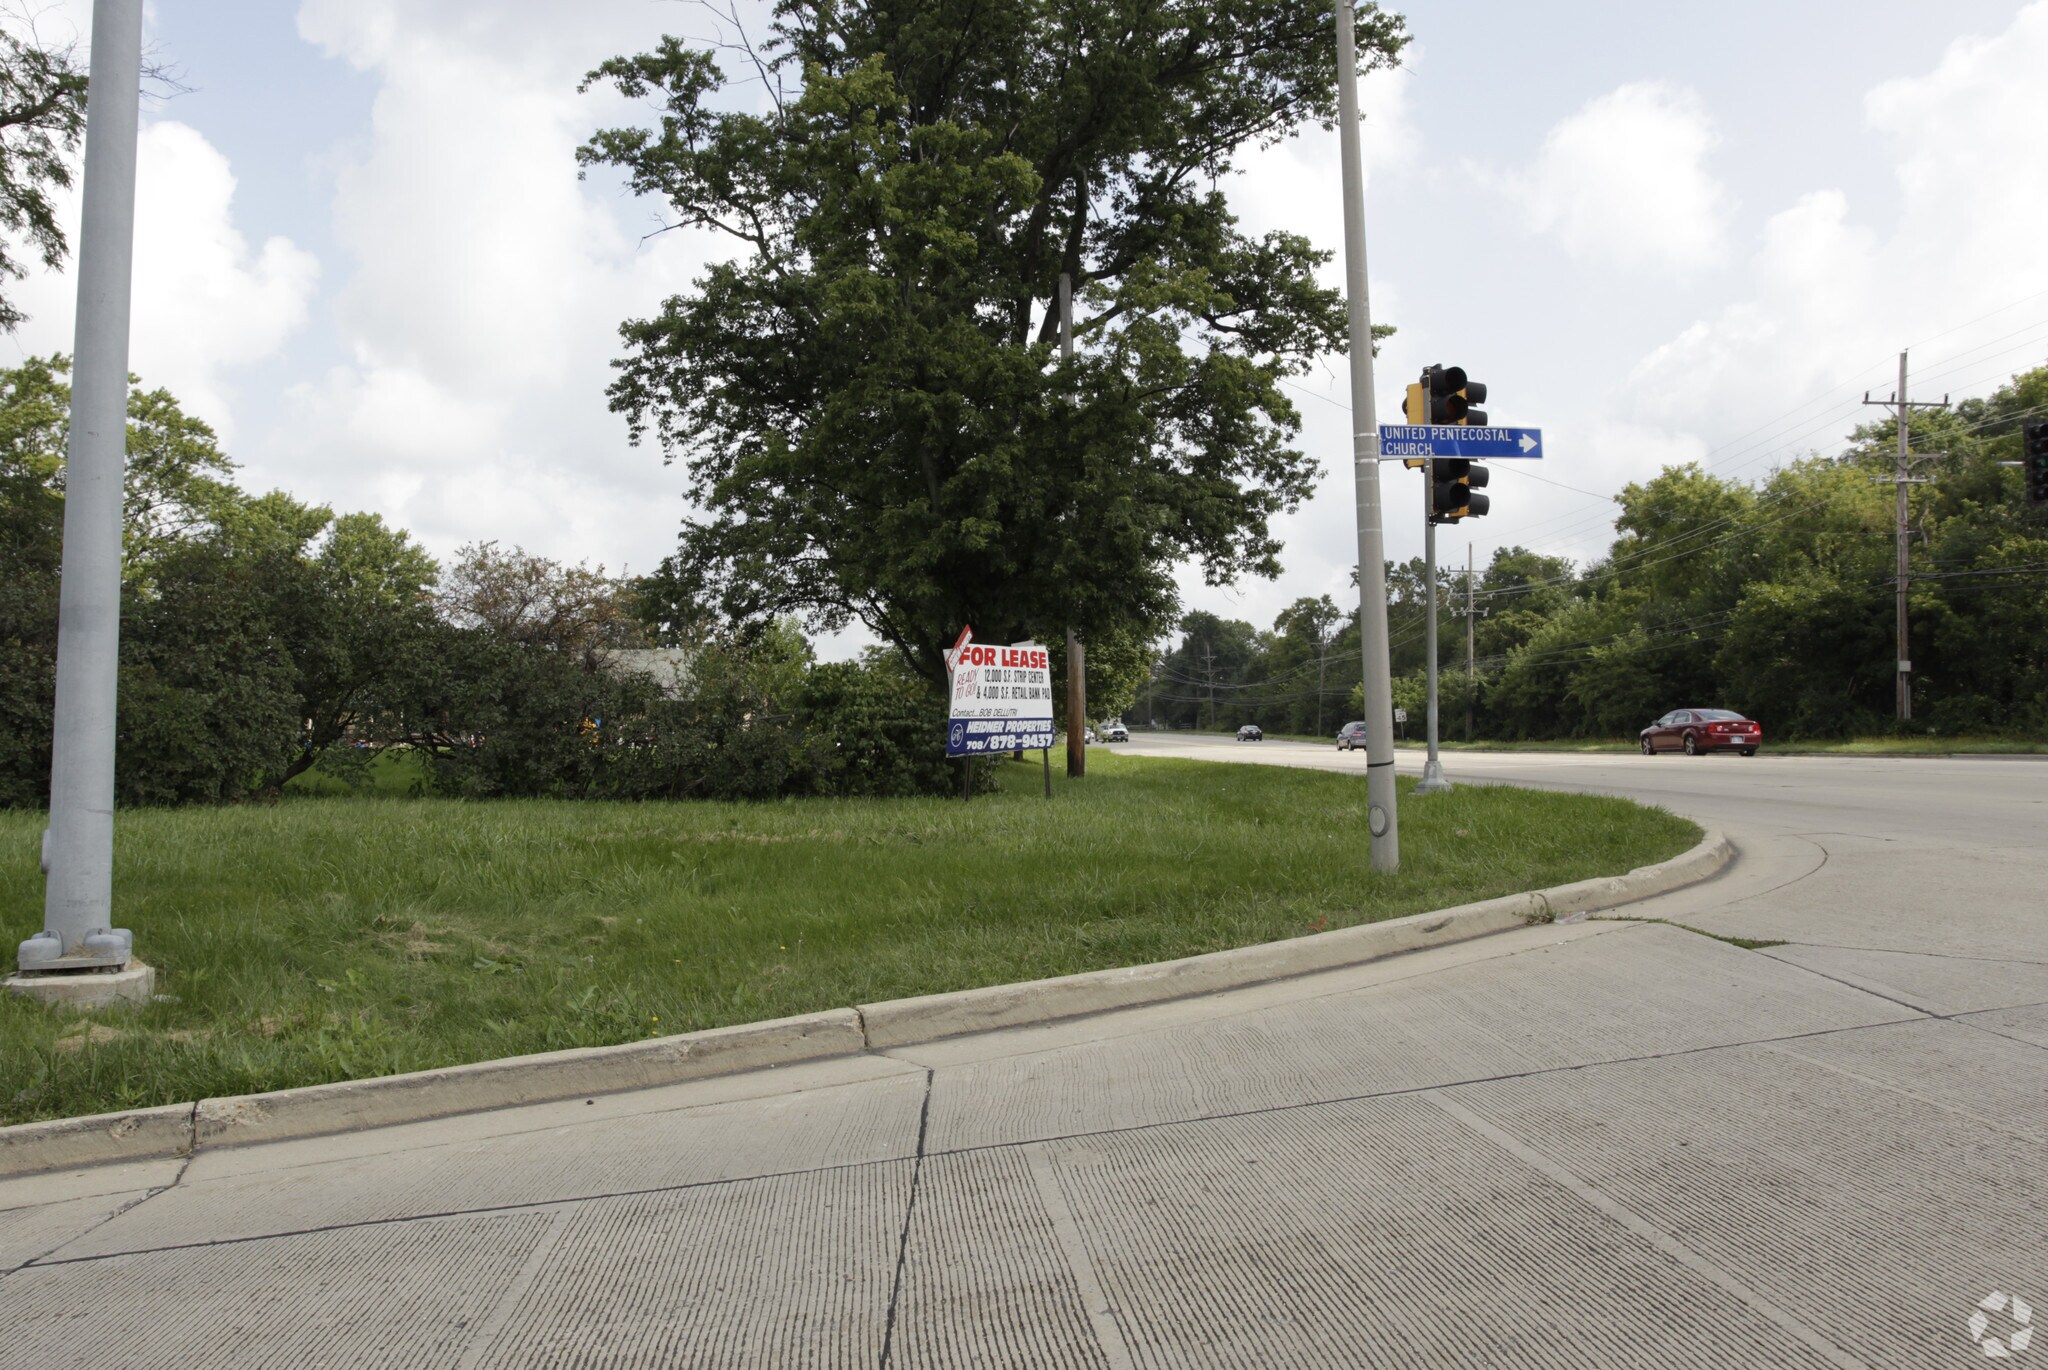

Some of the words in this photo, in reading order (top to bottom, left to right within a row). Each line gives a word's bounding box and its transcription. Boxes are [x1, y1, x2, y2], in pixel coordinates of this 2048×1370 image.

[1385, 427, 1426, 440] UNITED
[1431, 428, 1512, 442] PENTECOSTAL
[1386, 442, 1432, 455] CHURCH
[959, 647, 996, 666] FOR
[1001, 649, 1047, 669] LEASE
[956, 668, 979, 686] READY
[1014, 670, 1027, 683] STRIP
[1028, 671, 1044, 684] CENTER
[955, 686, 964, 700] TO
[1012, 687, 1028, 700] RETAIL
[1029, 687, 1041, 700] BANK
[1042, 688, 1050, 700] PAD
[966, 720, 1004, 734] HEIDNER
[1005, 720, 1052, 732] PROPERTIES
